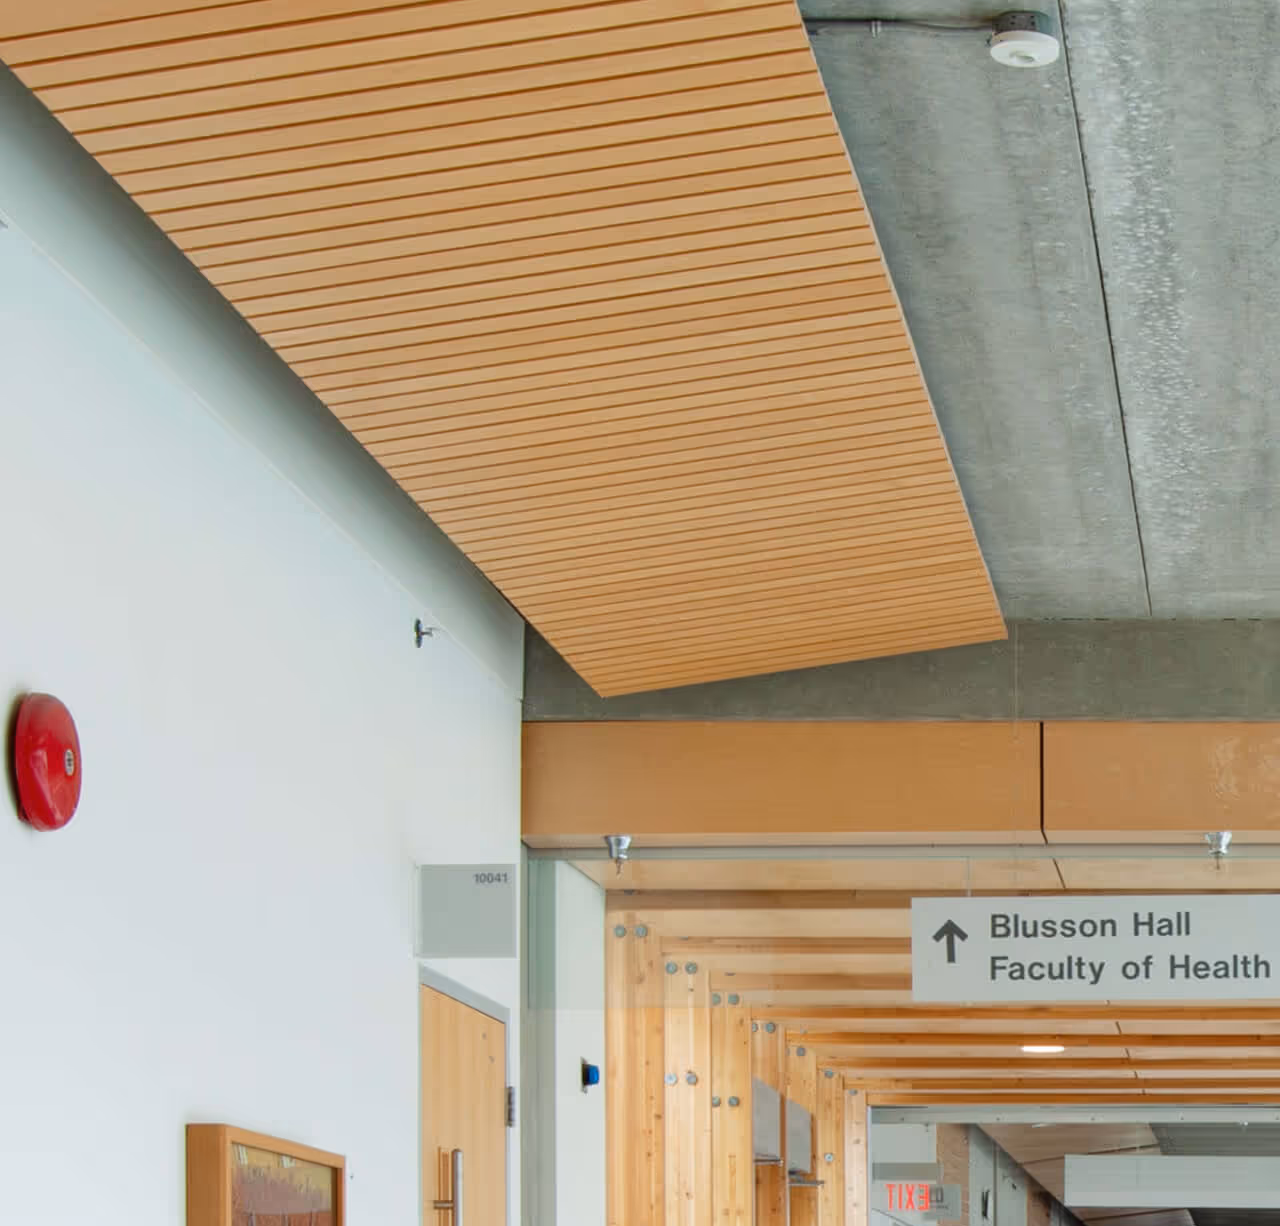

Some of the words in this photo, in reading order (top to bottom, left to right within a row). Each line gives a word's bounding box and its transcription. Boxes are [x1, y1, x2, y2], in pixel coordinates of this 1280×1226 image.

[991, 913, 1116, 939] Blusson
[1134, 911, 1191, 937] Hall
[991, 954, 1105, 985] Faculty
[1121, 954, 1152, 981] of
[1169, 953, 1271, 980] Health
